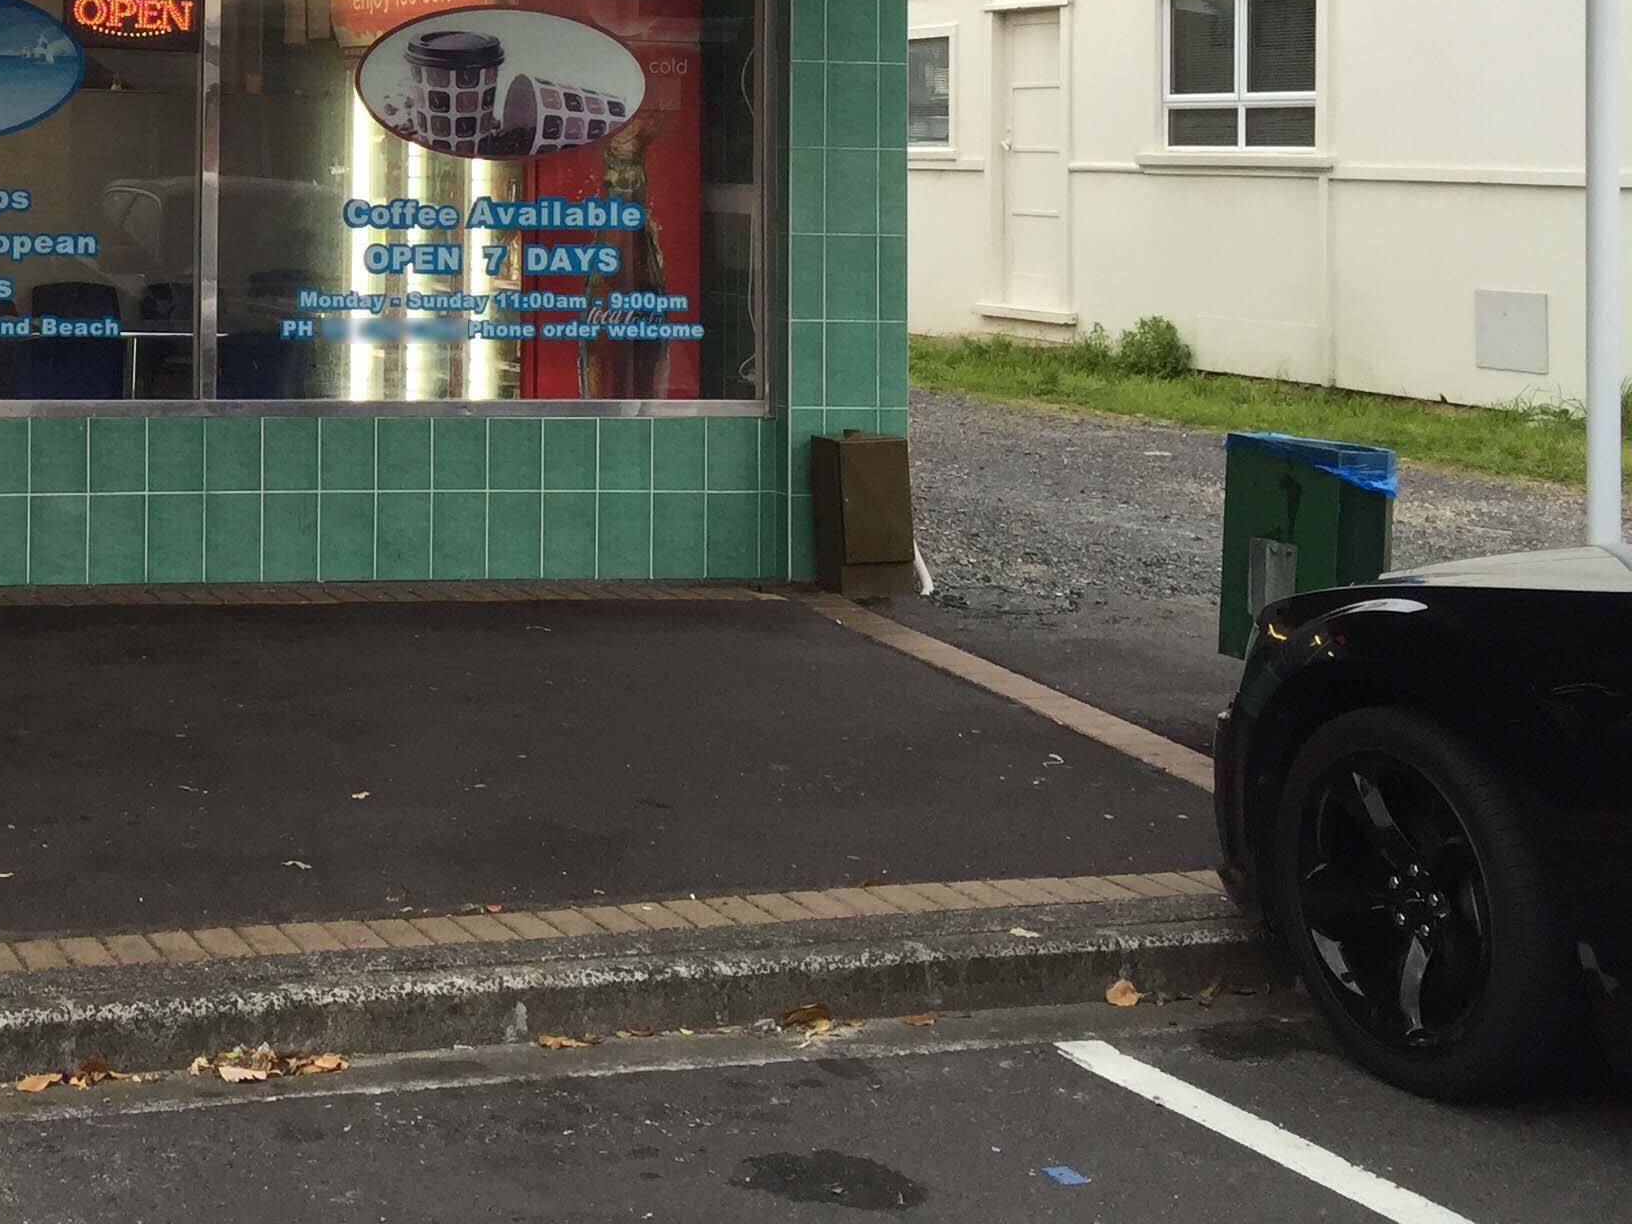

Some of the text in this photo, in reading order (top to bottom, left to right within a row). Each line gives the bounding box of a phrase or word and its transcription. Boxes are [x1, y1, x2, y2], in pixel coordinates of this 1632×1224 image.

[648, 57, 689, 75] cold
[345, 197, 643, 228] Coffee Available
[364, 245, 619, 272] OPEN 7 DAYS
[299, 290, 386, 314] Monday
[405, 290, 490, 313] Sunday
[495, 291, 588, 310] 11:00am
[609, 291, 689, 313] 9:00pm
[41, 317, 121, 338] Beach
[281, 319, 314, 338] PH
[468, 320, 536, 339] Phone
[542, 320, 600, 339] order
[607, 320, 706, 339] welcome
